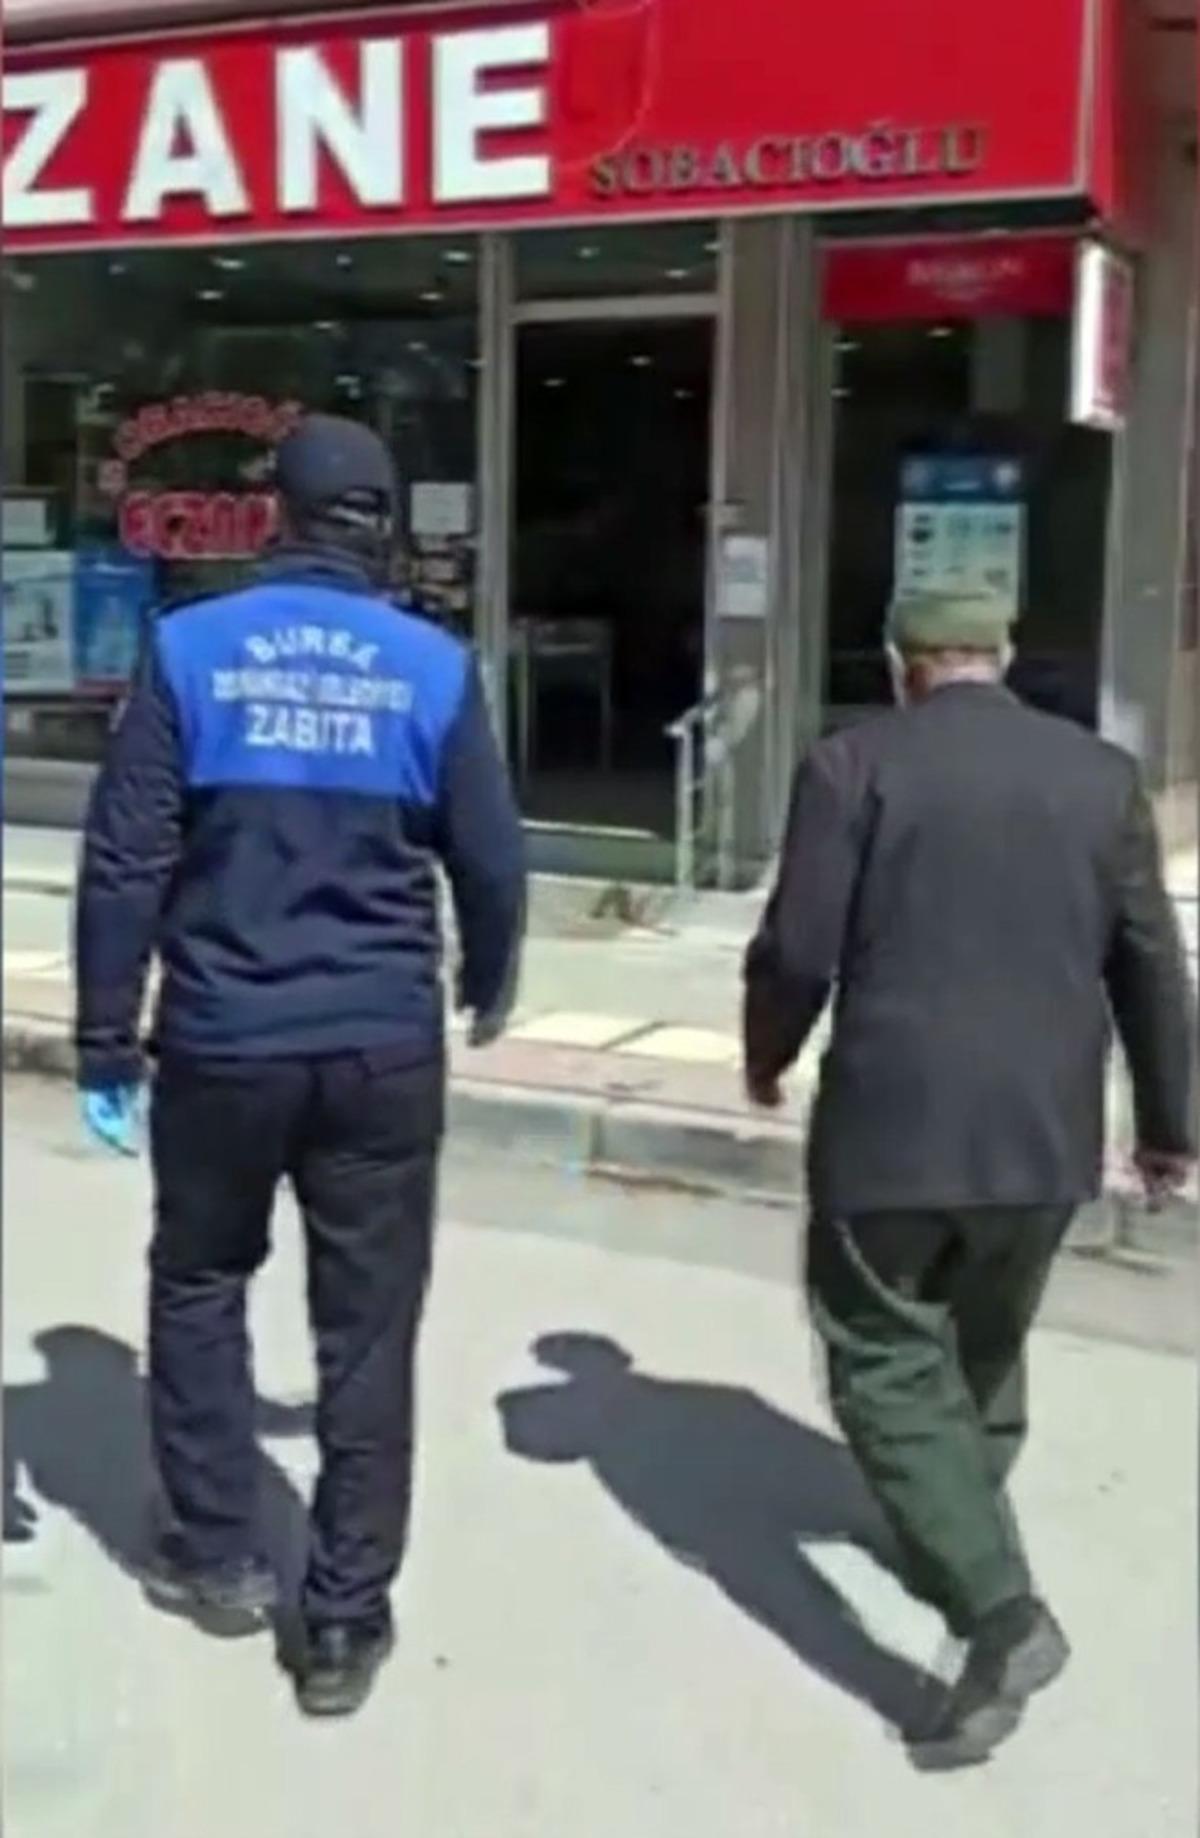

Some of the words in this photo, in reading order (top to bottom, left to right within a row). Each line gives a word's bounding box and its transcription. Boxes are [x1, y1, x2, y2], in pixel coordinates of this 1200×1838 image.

[3, 22, 550, 227] ZANE
[245, 625, 380, 671] BURSA
[246, 704, 375, 757] ZABITA
